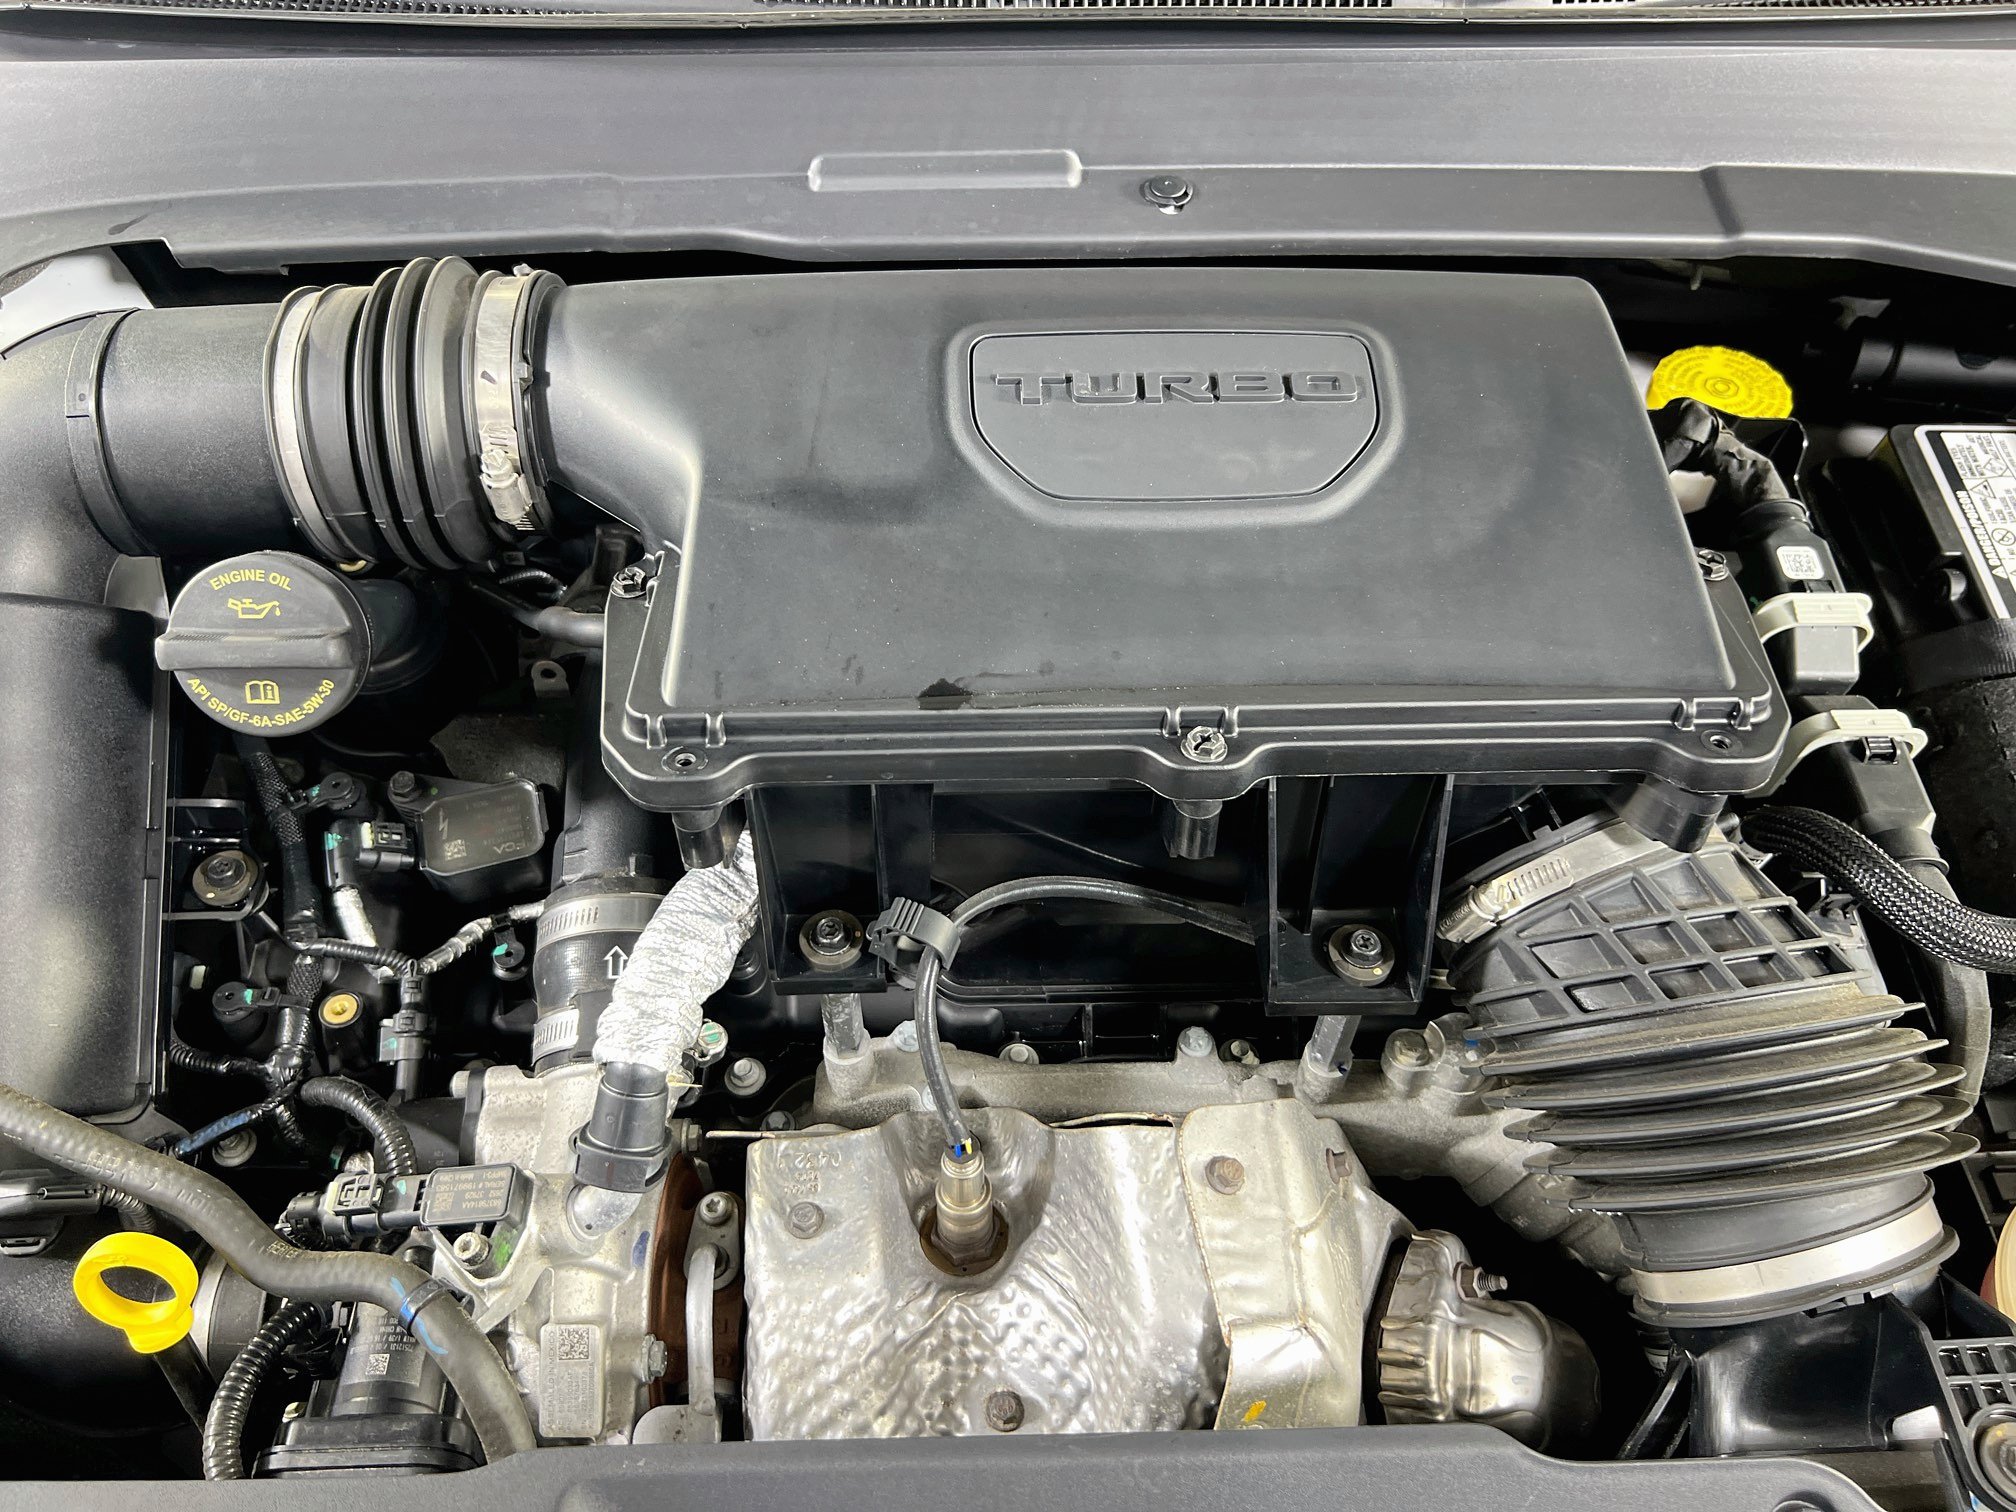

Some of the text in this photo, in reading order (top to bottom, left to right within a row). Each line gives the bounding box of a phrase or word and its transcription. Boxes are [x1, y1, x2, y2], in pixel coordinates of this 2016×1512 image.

[994, 371, 1359, 405] TURBO
[1956, 490, 2001, 566] DANGER/POISON
[208, 568, 294, 591] ENGINE OIL
[187, 676, 335, 728] API SP/GF-6A-SAE-5W-30
